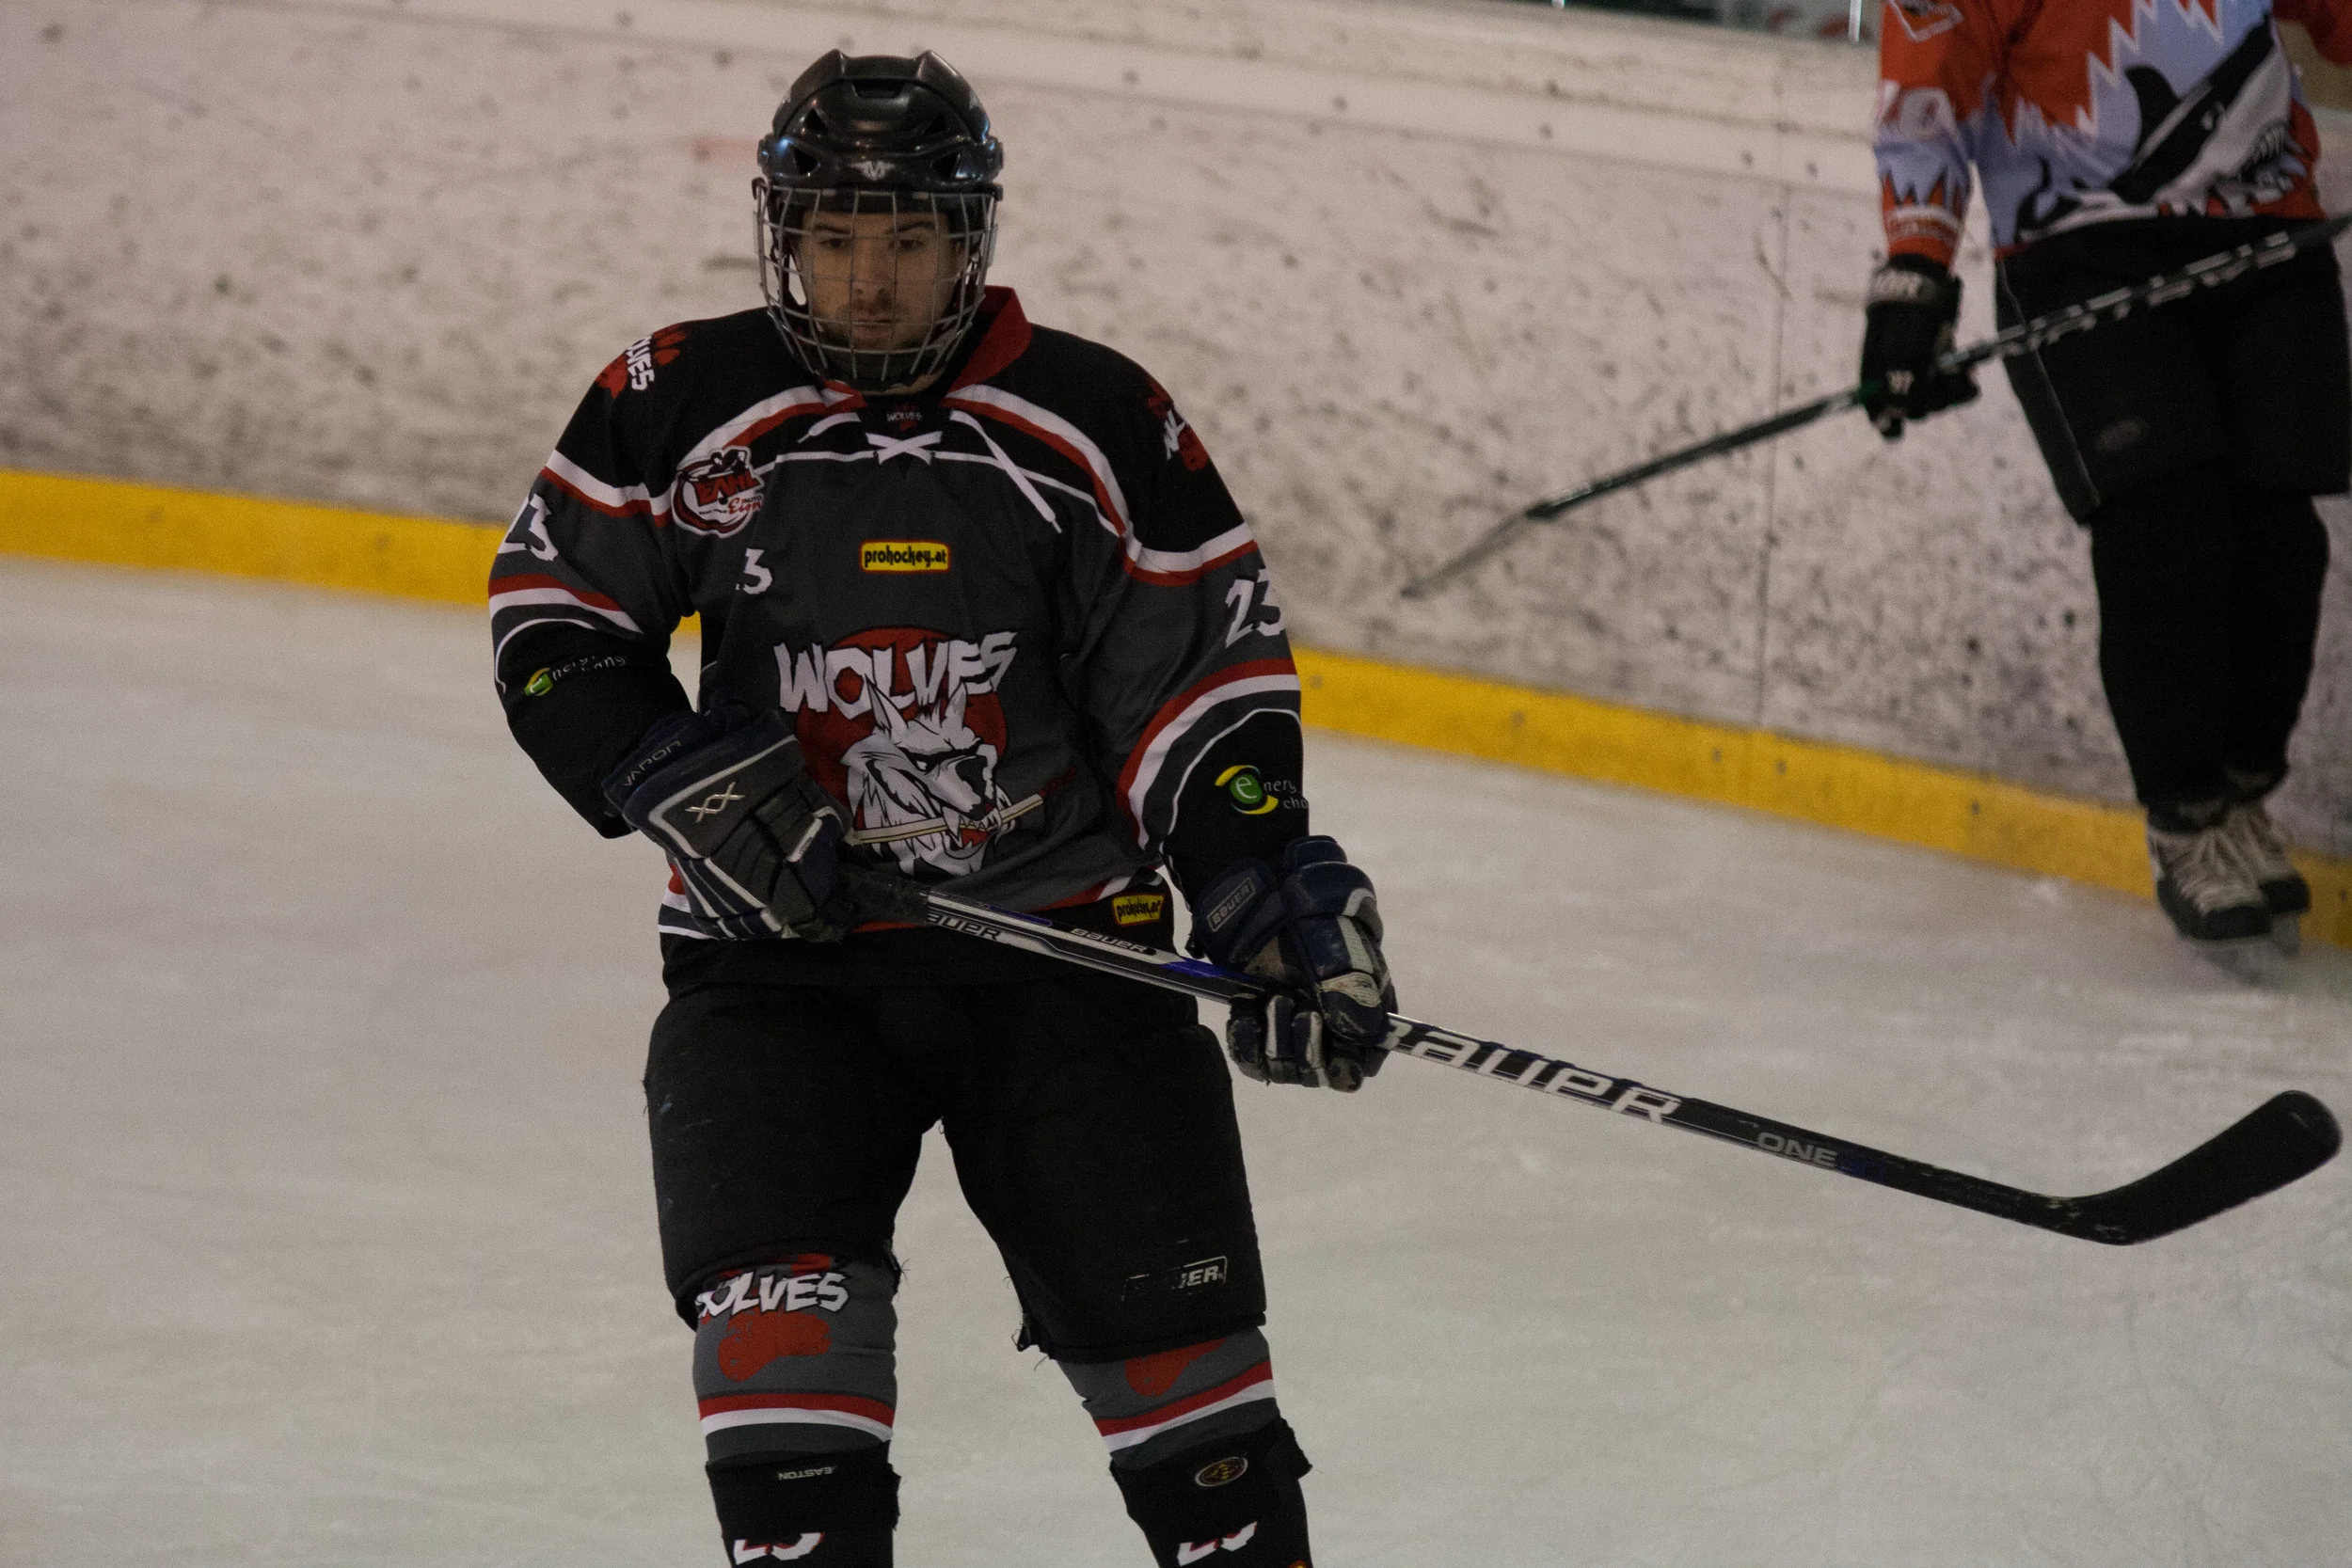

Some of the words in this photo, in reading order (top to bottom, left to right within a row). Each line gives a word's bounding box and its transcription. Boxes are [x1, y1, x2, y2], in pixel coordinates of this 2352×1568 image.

[864, 545, 946, 568] prohockey.at
[1225, 568, 1285, 649] 23
[772, 630, 1019, 721] WOLVES
[927, 911, 1001, 941] AUER
[1071, 927, 1148, 954] BAUER
[1756, 1131, 1838, 1169] ONE
